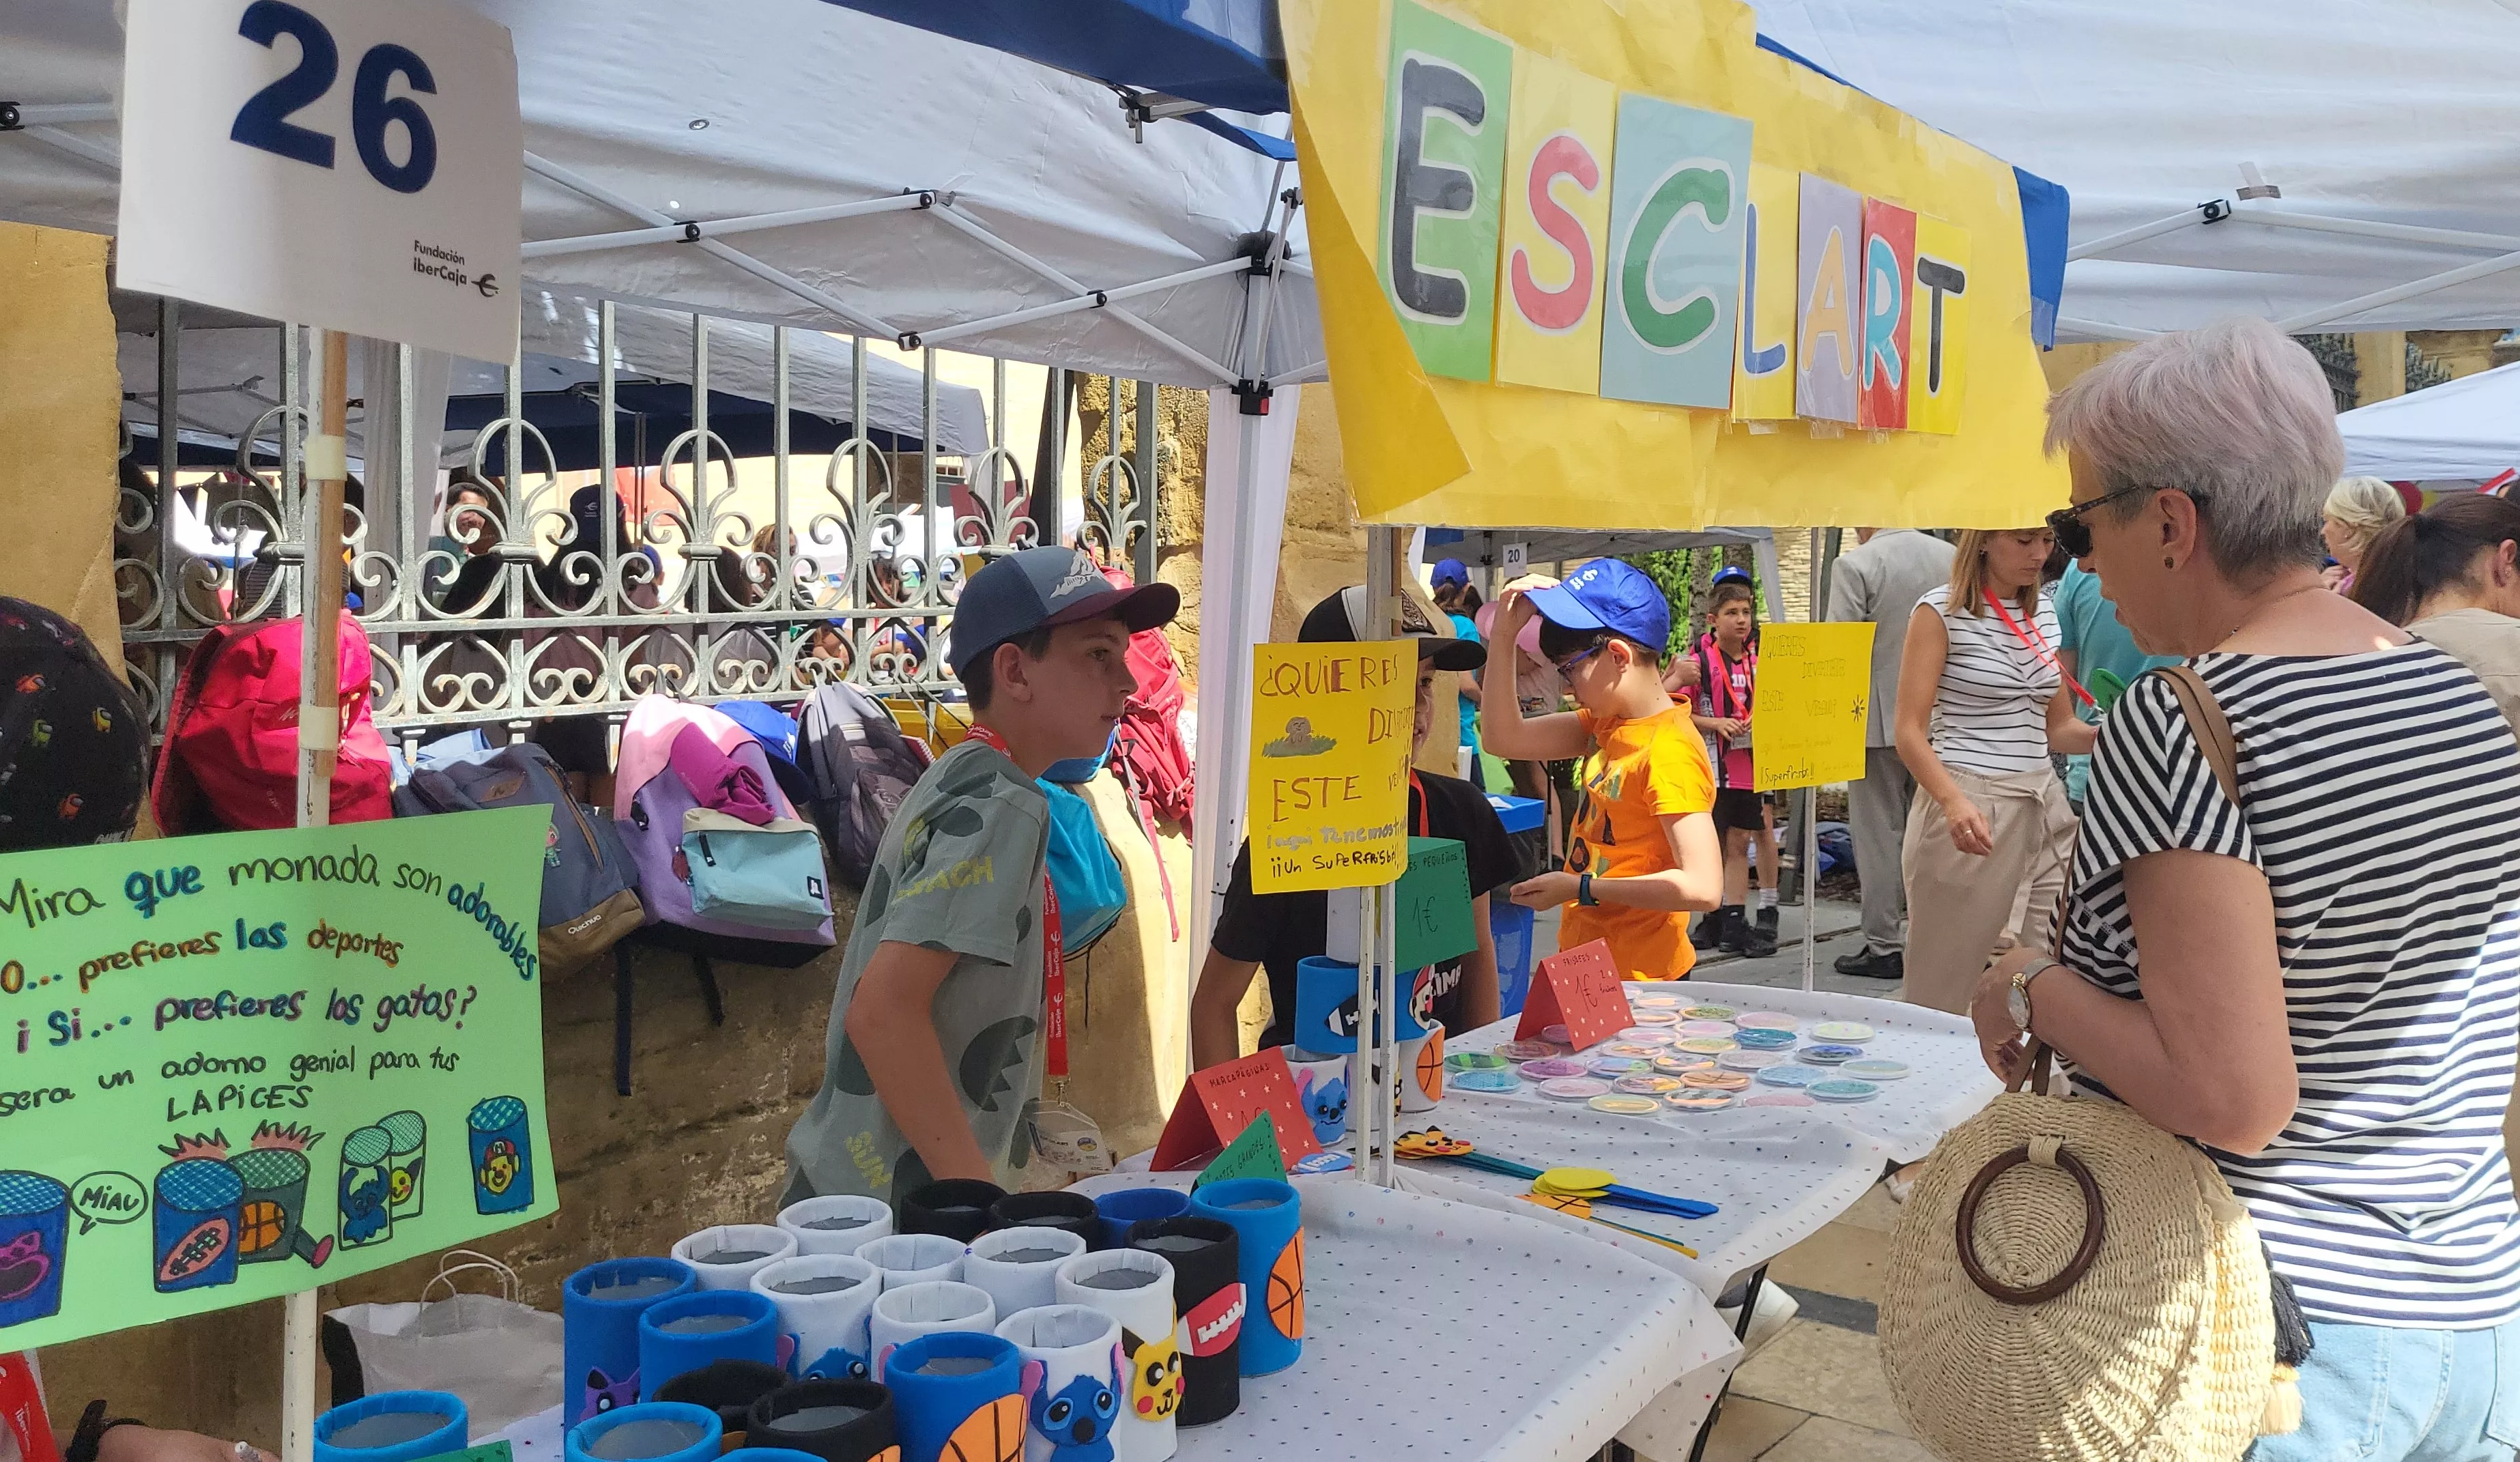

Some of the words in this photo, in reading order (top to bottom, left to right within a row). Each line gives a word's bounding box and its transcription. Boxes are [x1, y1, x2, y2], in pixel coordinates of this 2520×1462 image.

[230, 0, 437, 194] 26
[1390, 49, 1966, 398] ESCLART
[414, 239, 466, 266] Fundación
[1508, 548, 1520, 563] 20
[1272, 774, 1363, 823] ESTE
[0, 877, 106, 928] Mira
[124, 864, 205, 919] que
[229, 844, 380, 887] monada
[392, 863, 442, 896] son
[447, 881, 537, 981] adorables
[568, 915, 602, 934] Quechua
[1412, 895, 1439, 938] 1€
[78, 930, 222, 994] prefieres
[307, 918, 404, 968] deportes
[154, 988, 309, 1032] prefieres
[1575, 973, 1598, 1014] 1€
[98, 1070, 134, 1090] un
[289, 1045, 356, 1083] genial
[369, 1048, 421, 1080] para
[431, 1045, 461, 1072] tus
